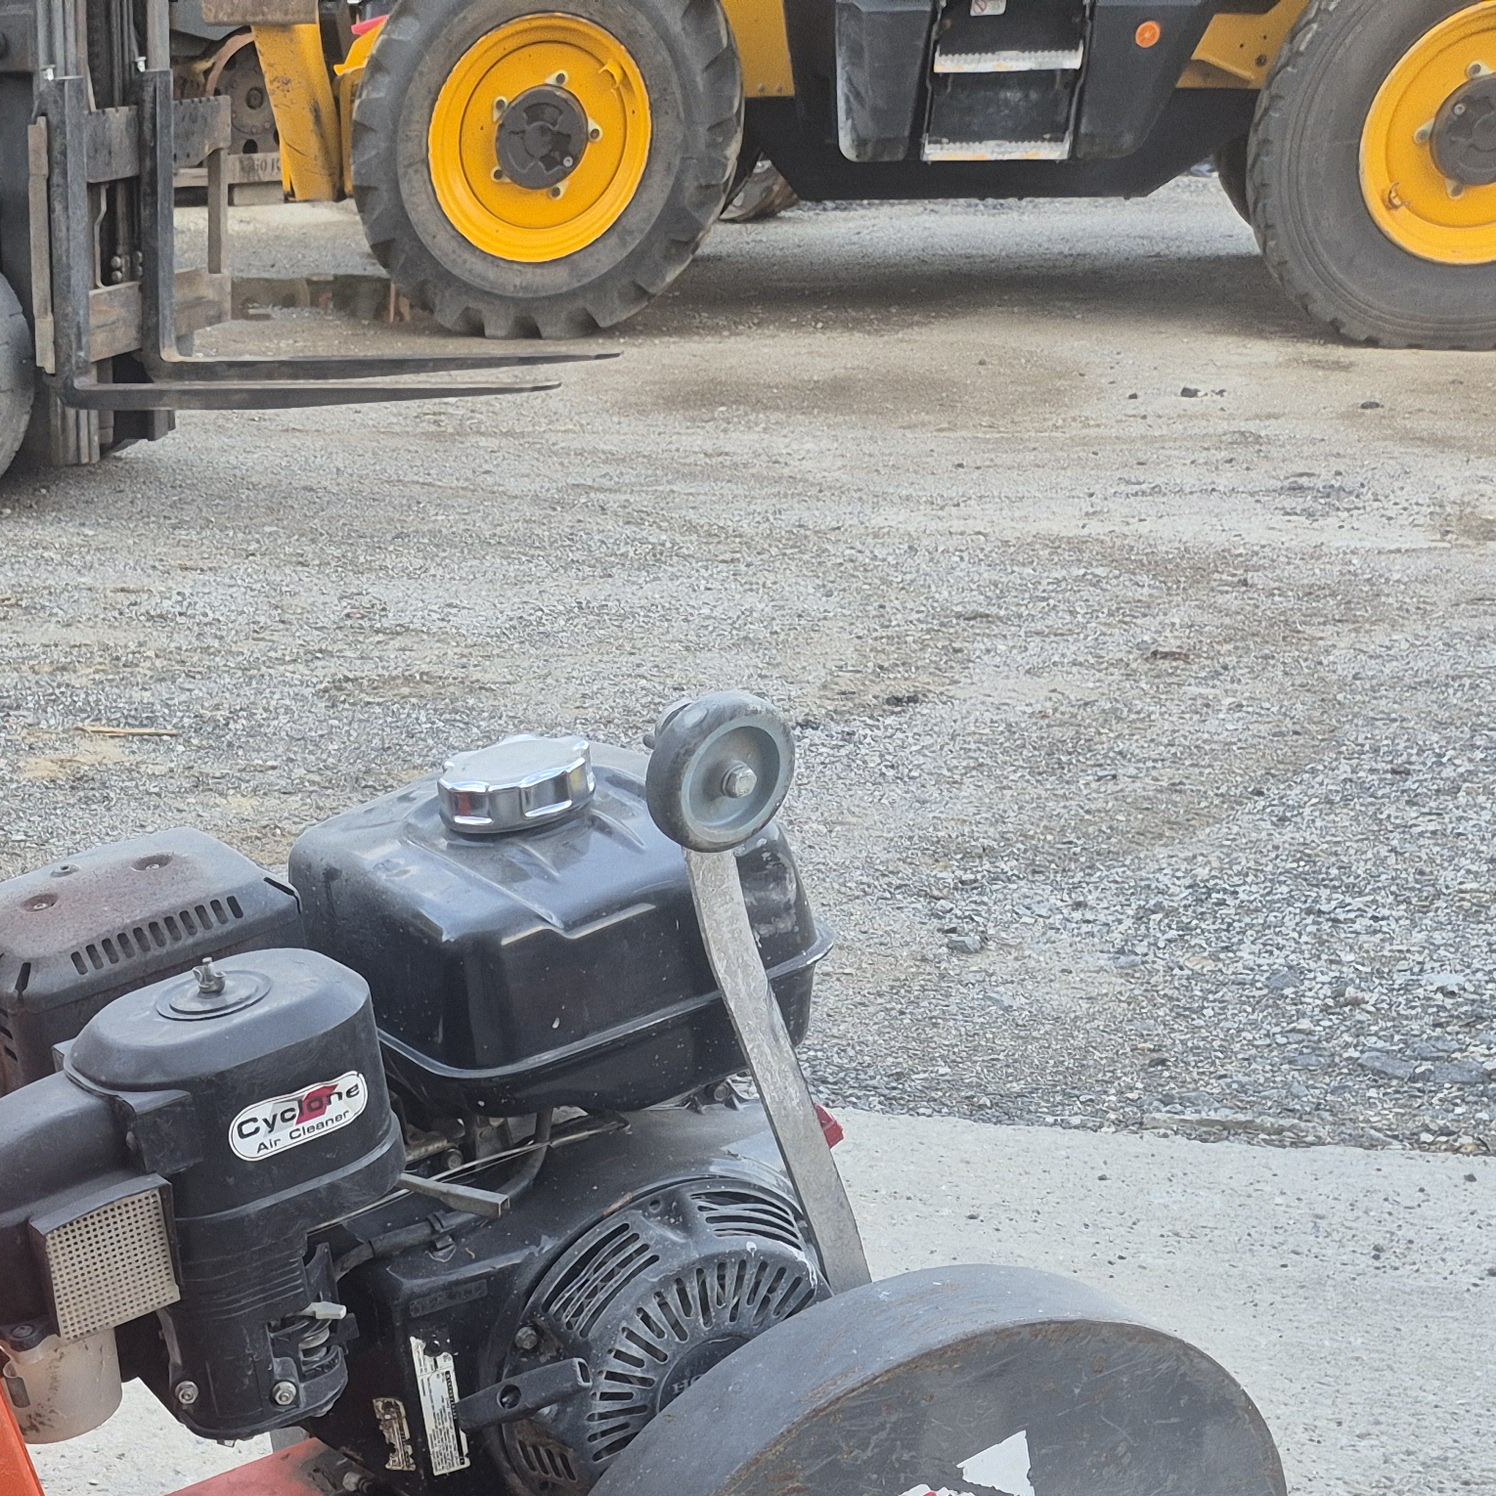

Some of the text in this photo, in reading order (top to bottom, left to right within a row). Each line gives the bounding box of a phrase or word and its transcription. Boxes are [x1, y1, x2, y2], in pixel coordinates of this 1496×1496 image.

[236, 1083, 361, 1140] Cyclone
[256, 1108, 350, 1154] Air Cleaner
